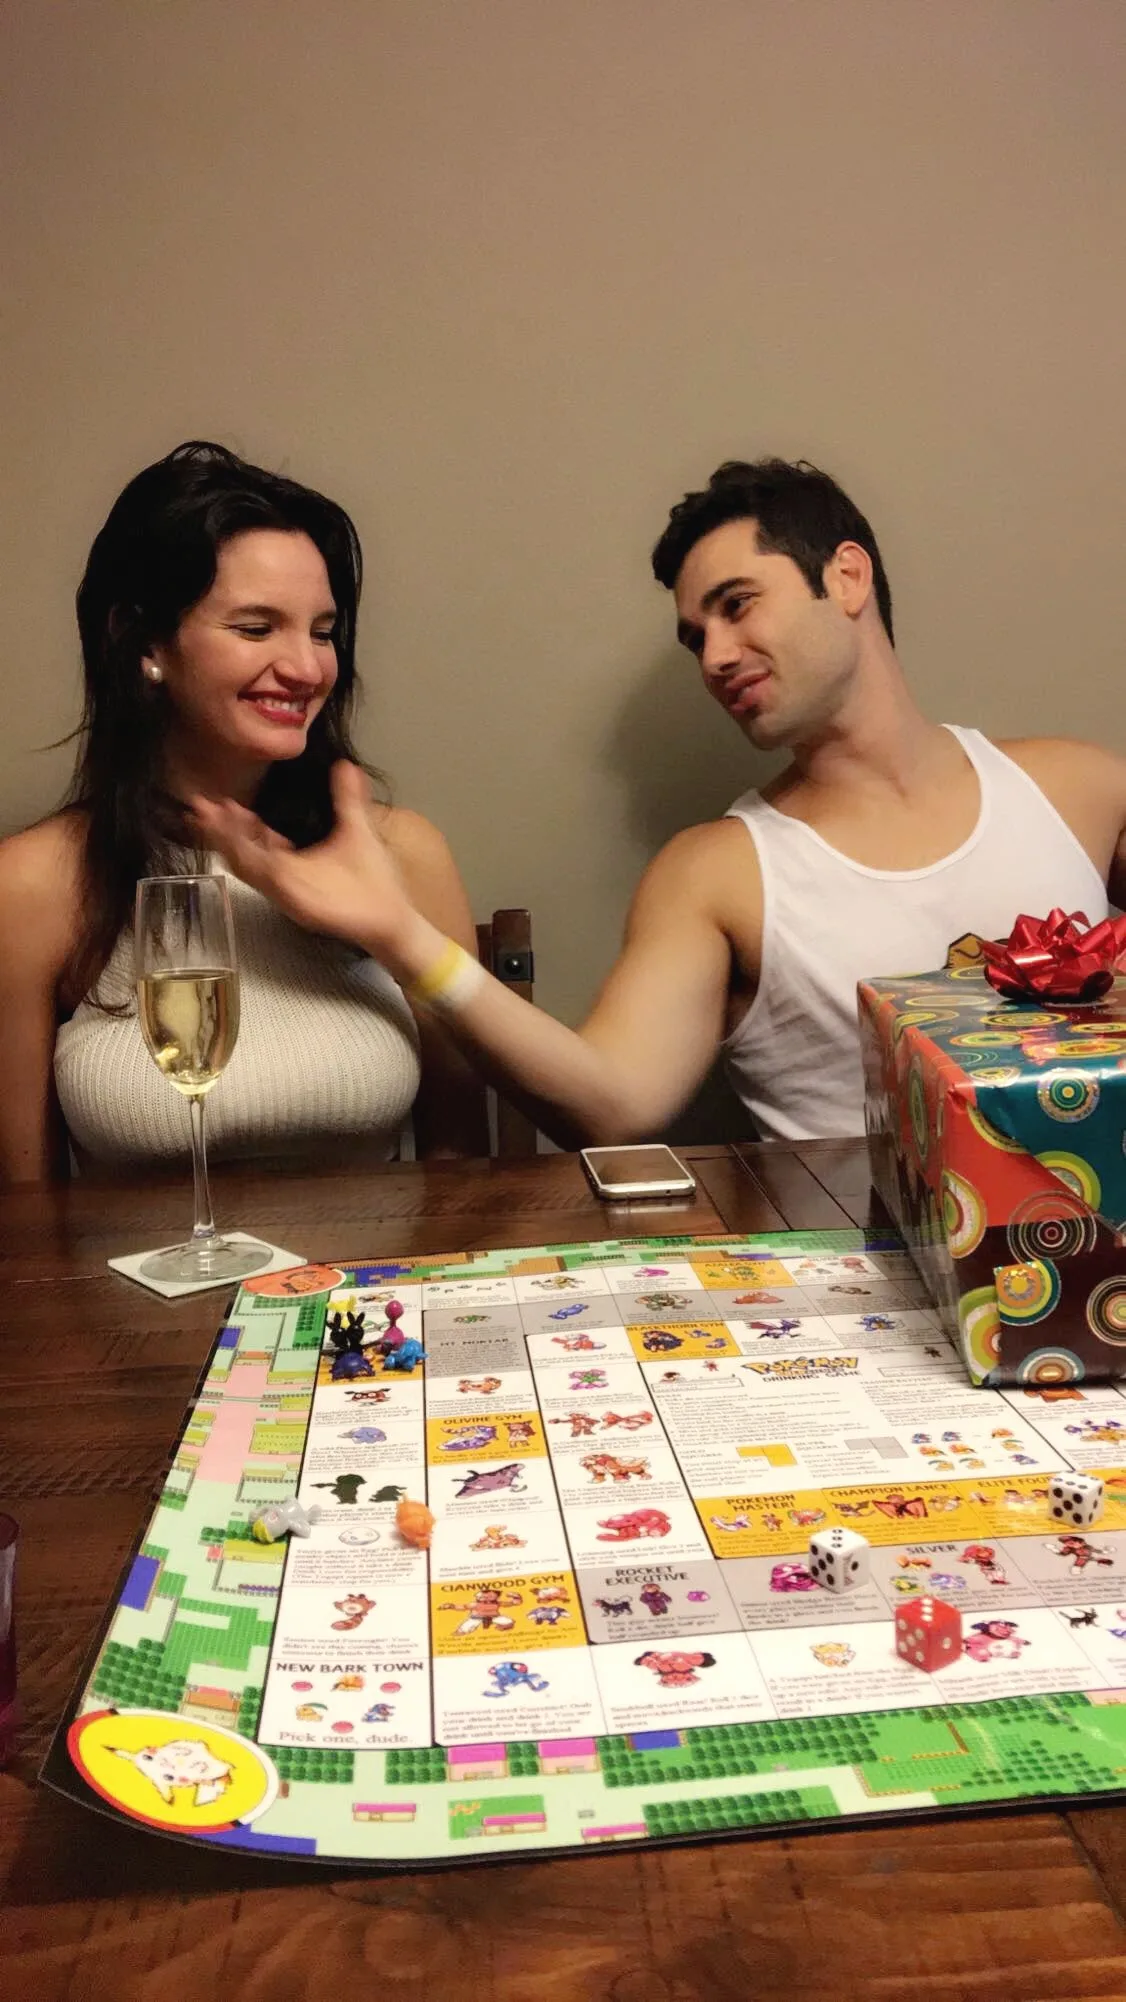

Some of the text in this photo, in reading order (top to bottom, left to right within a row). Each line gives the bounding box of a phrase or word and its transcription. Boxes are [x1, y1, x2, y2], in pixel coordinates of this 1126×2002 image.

[762, 1374, 820, 1383] DRINKING
[825, 1370, 861, 1378] GAME
[443, 1416, 491, 1425] OLIVINE
[977, 1479, 1014, 1488] ELITE
[830, 1483, 949, 1497] CHAMPION LANCE
[725, 1494, 796, 1506] POKEMON
[732, 1502, 796, 1513] MASTER!
[906, 1544, 957, 1555] SILVER
[615, 1565, 675, 1577] ROCKET
[440, 1574, 565, 1593] CIANWOOD GYM
[605, 1572, 690, 1586] EXECUTIVE
[275, 1661, 424, 1674] NEW BARK TOWN
[278, 1731, 414, 1745] Pick one, dude.
